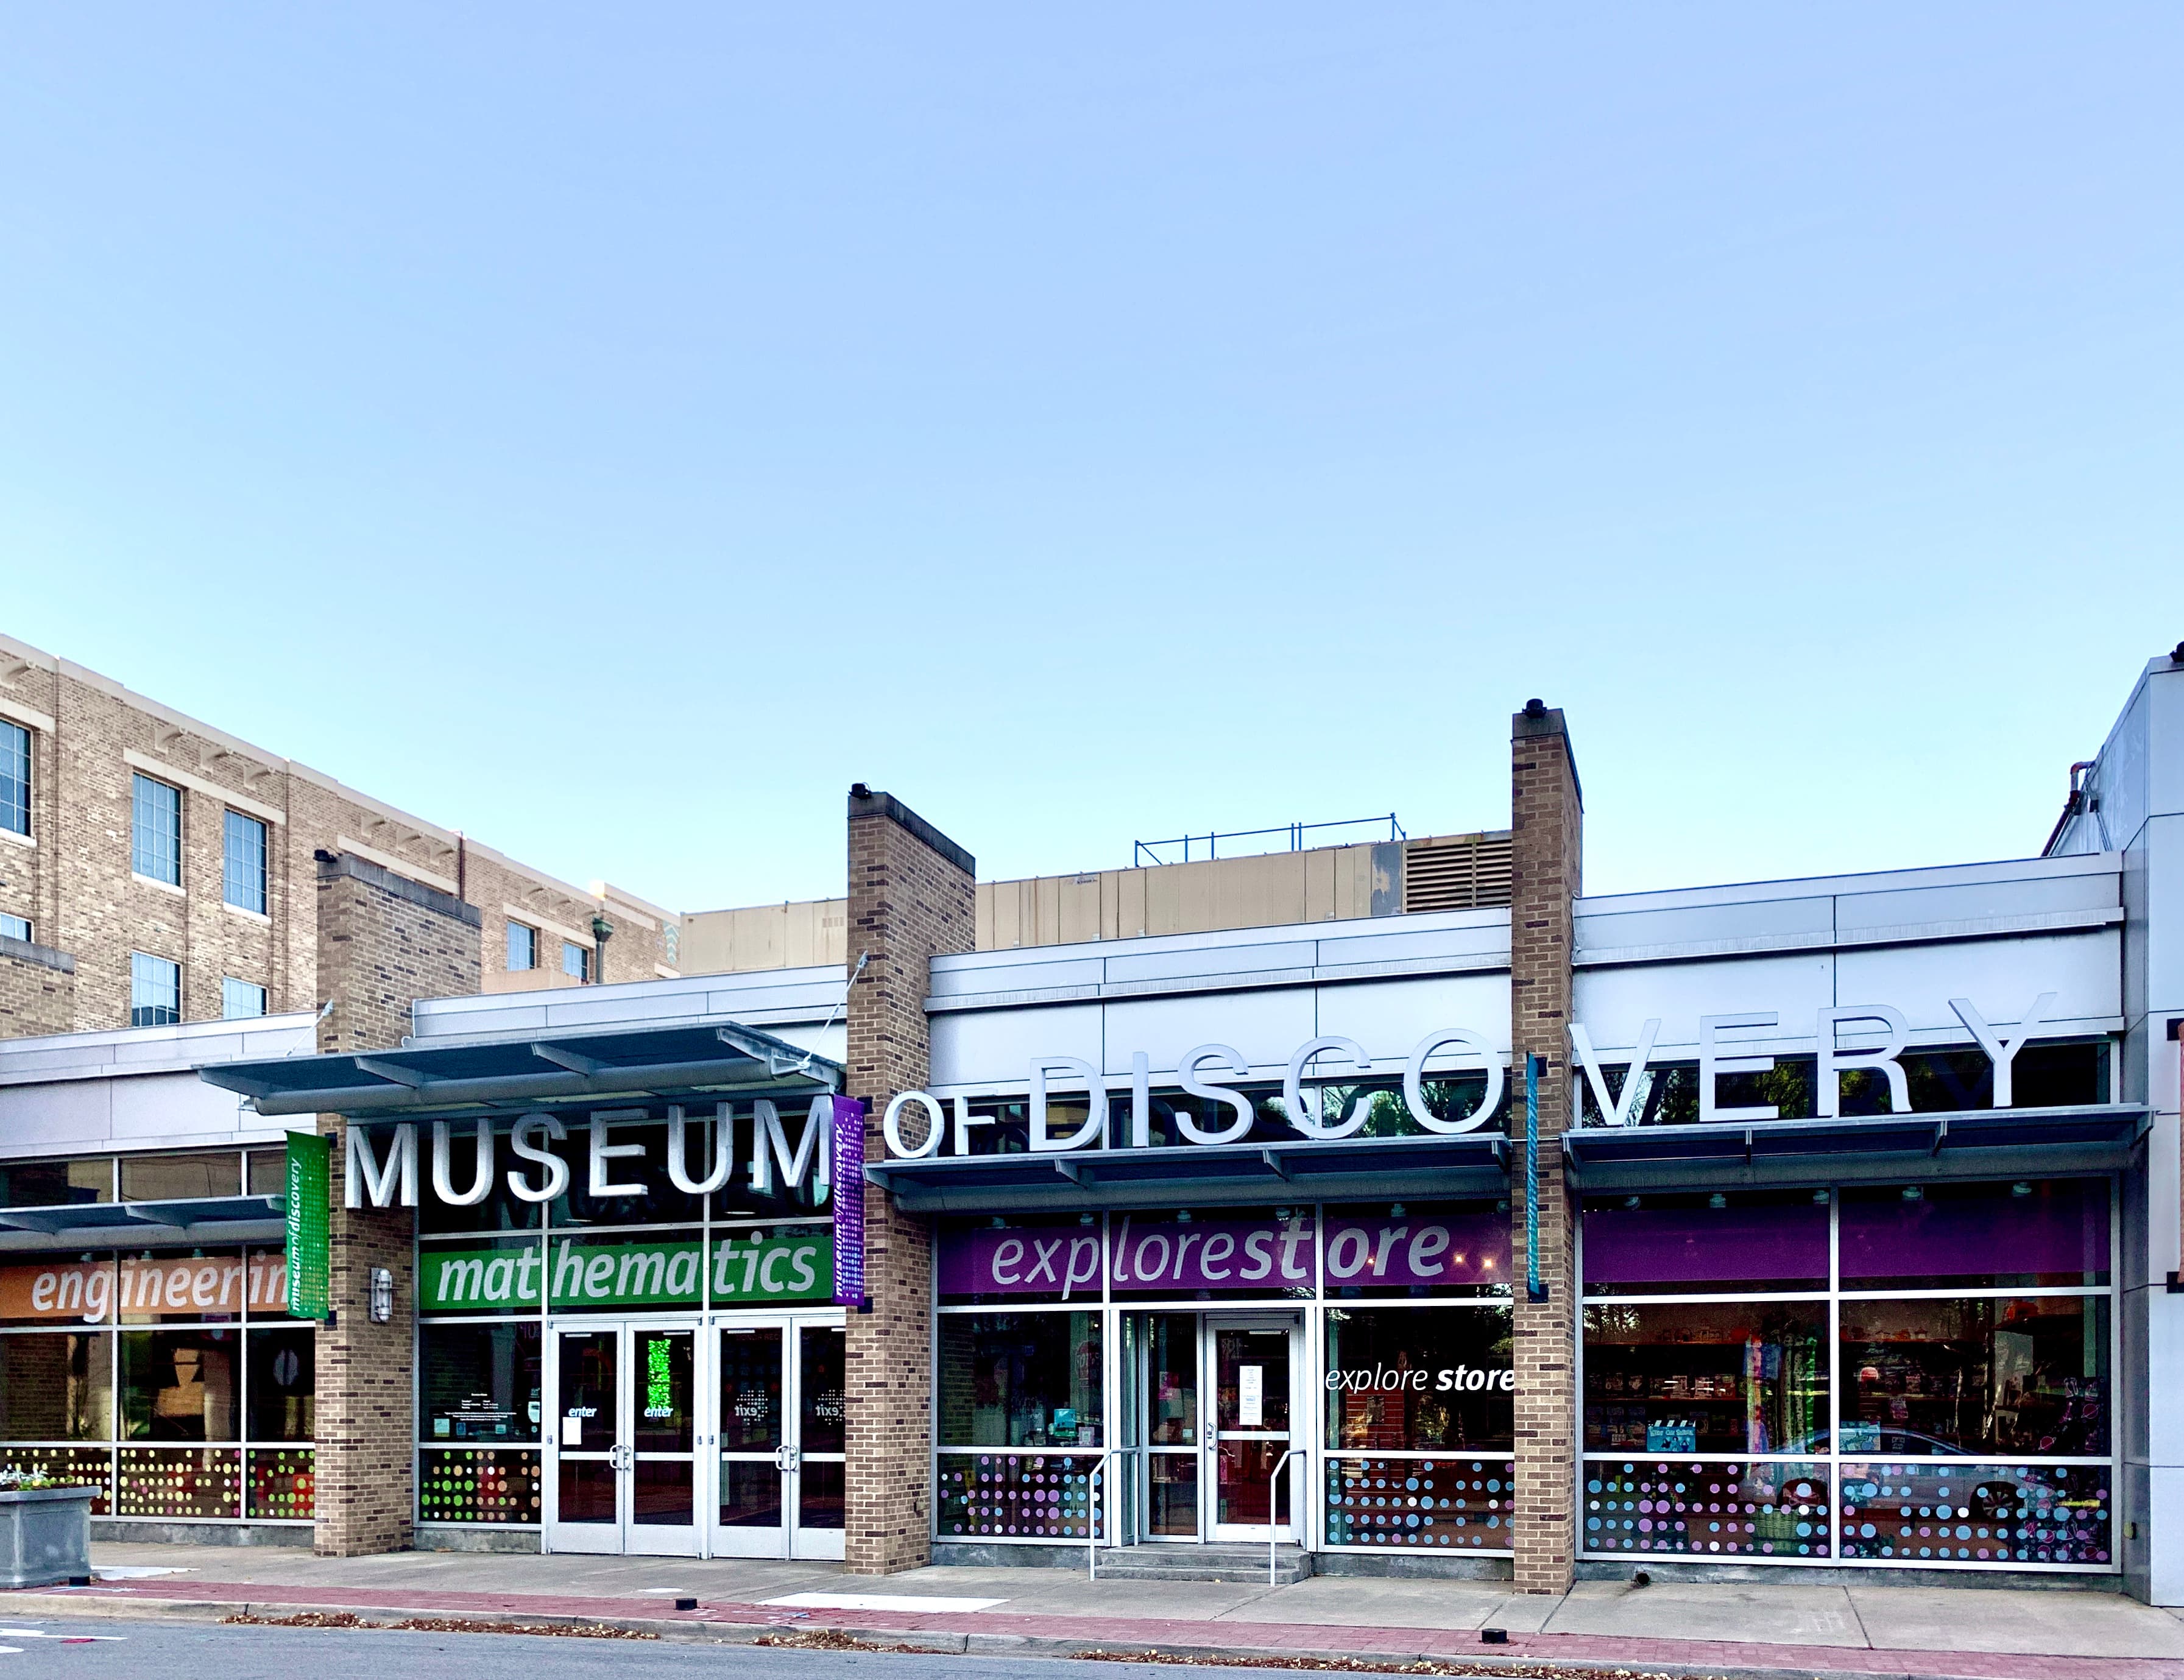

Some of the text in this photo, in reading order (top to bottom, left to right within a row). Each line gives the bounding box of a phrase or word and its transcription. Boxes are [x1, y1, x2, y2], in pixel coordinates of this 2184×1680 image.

[345, 1095, 834, 1209] MUSEUM
[883, 1088, 997, 1159] OF
[32, 1249, 288, 1323] engineerin
[437, 1230, 818, 1302] mathematics
[1325, 1362, 1514, 1394] explore store
[568, 1406, 597, 1417] enter
[644, 1406, 673, 1417] enter
